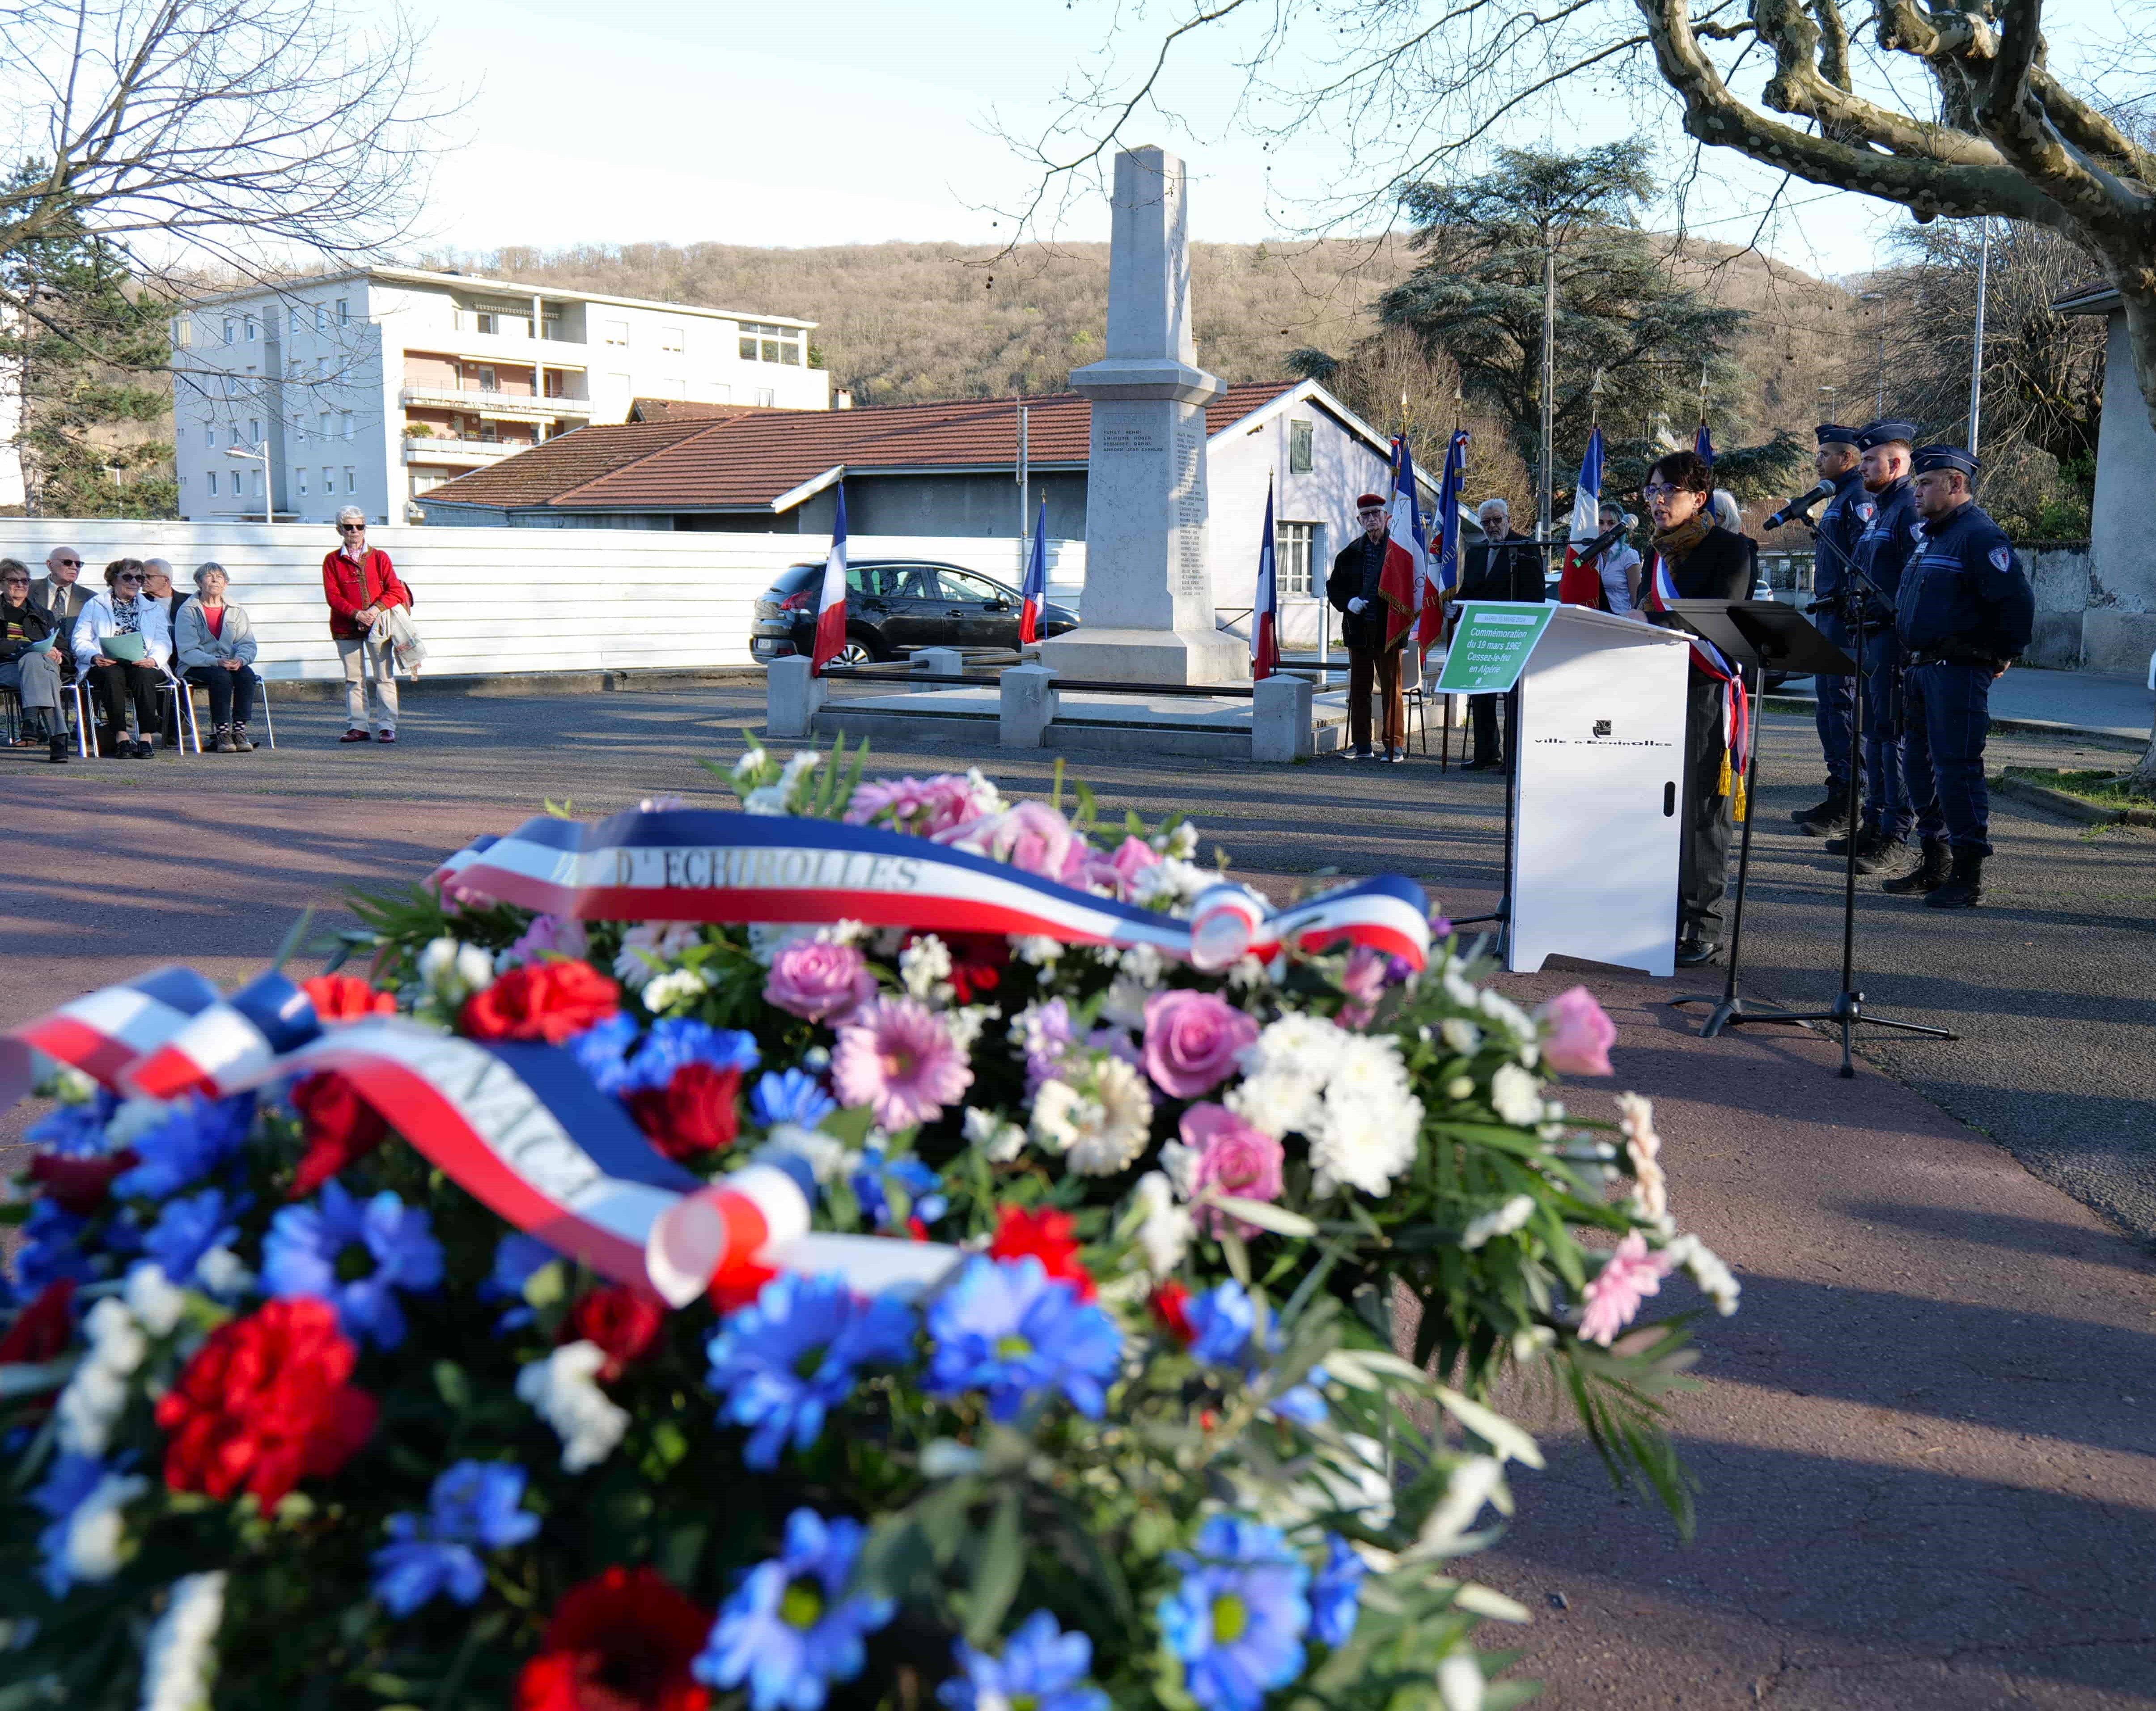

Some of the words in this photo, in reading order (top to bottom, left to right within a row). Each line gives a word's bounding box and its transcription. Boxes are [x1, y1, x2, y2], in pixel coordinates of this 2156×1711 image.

[1470, 627, 1527, 638] Commémoration
[1467, 640, 1476, 648] du
[1477, 640, 1486, 649] 19
[1505, 641, 1521, 650] 1962
[1467, 652, 1511, 662] Cessez-le-feu
[1478, 665, 1501, 675] Algérie
